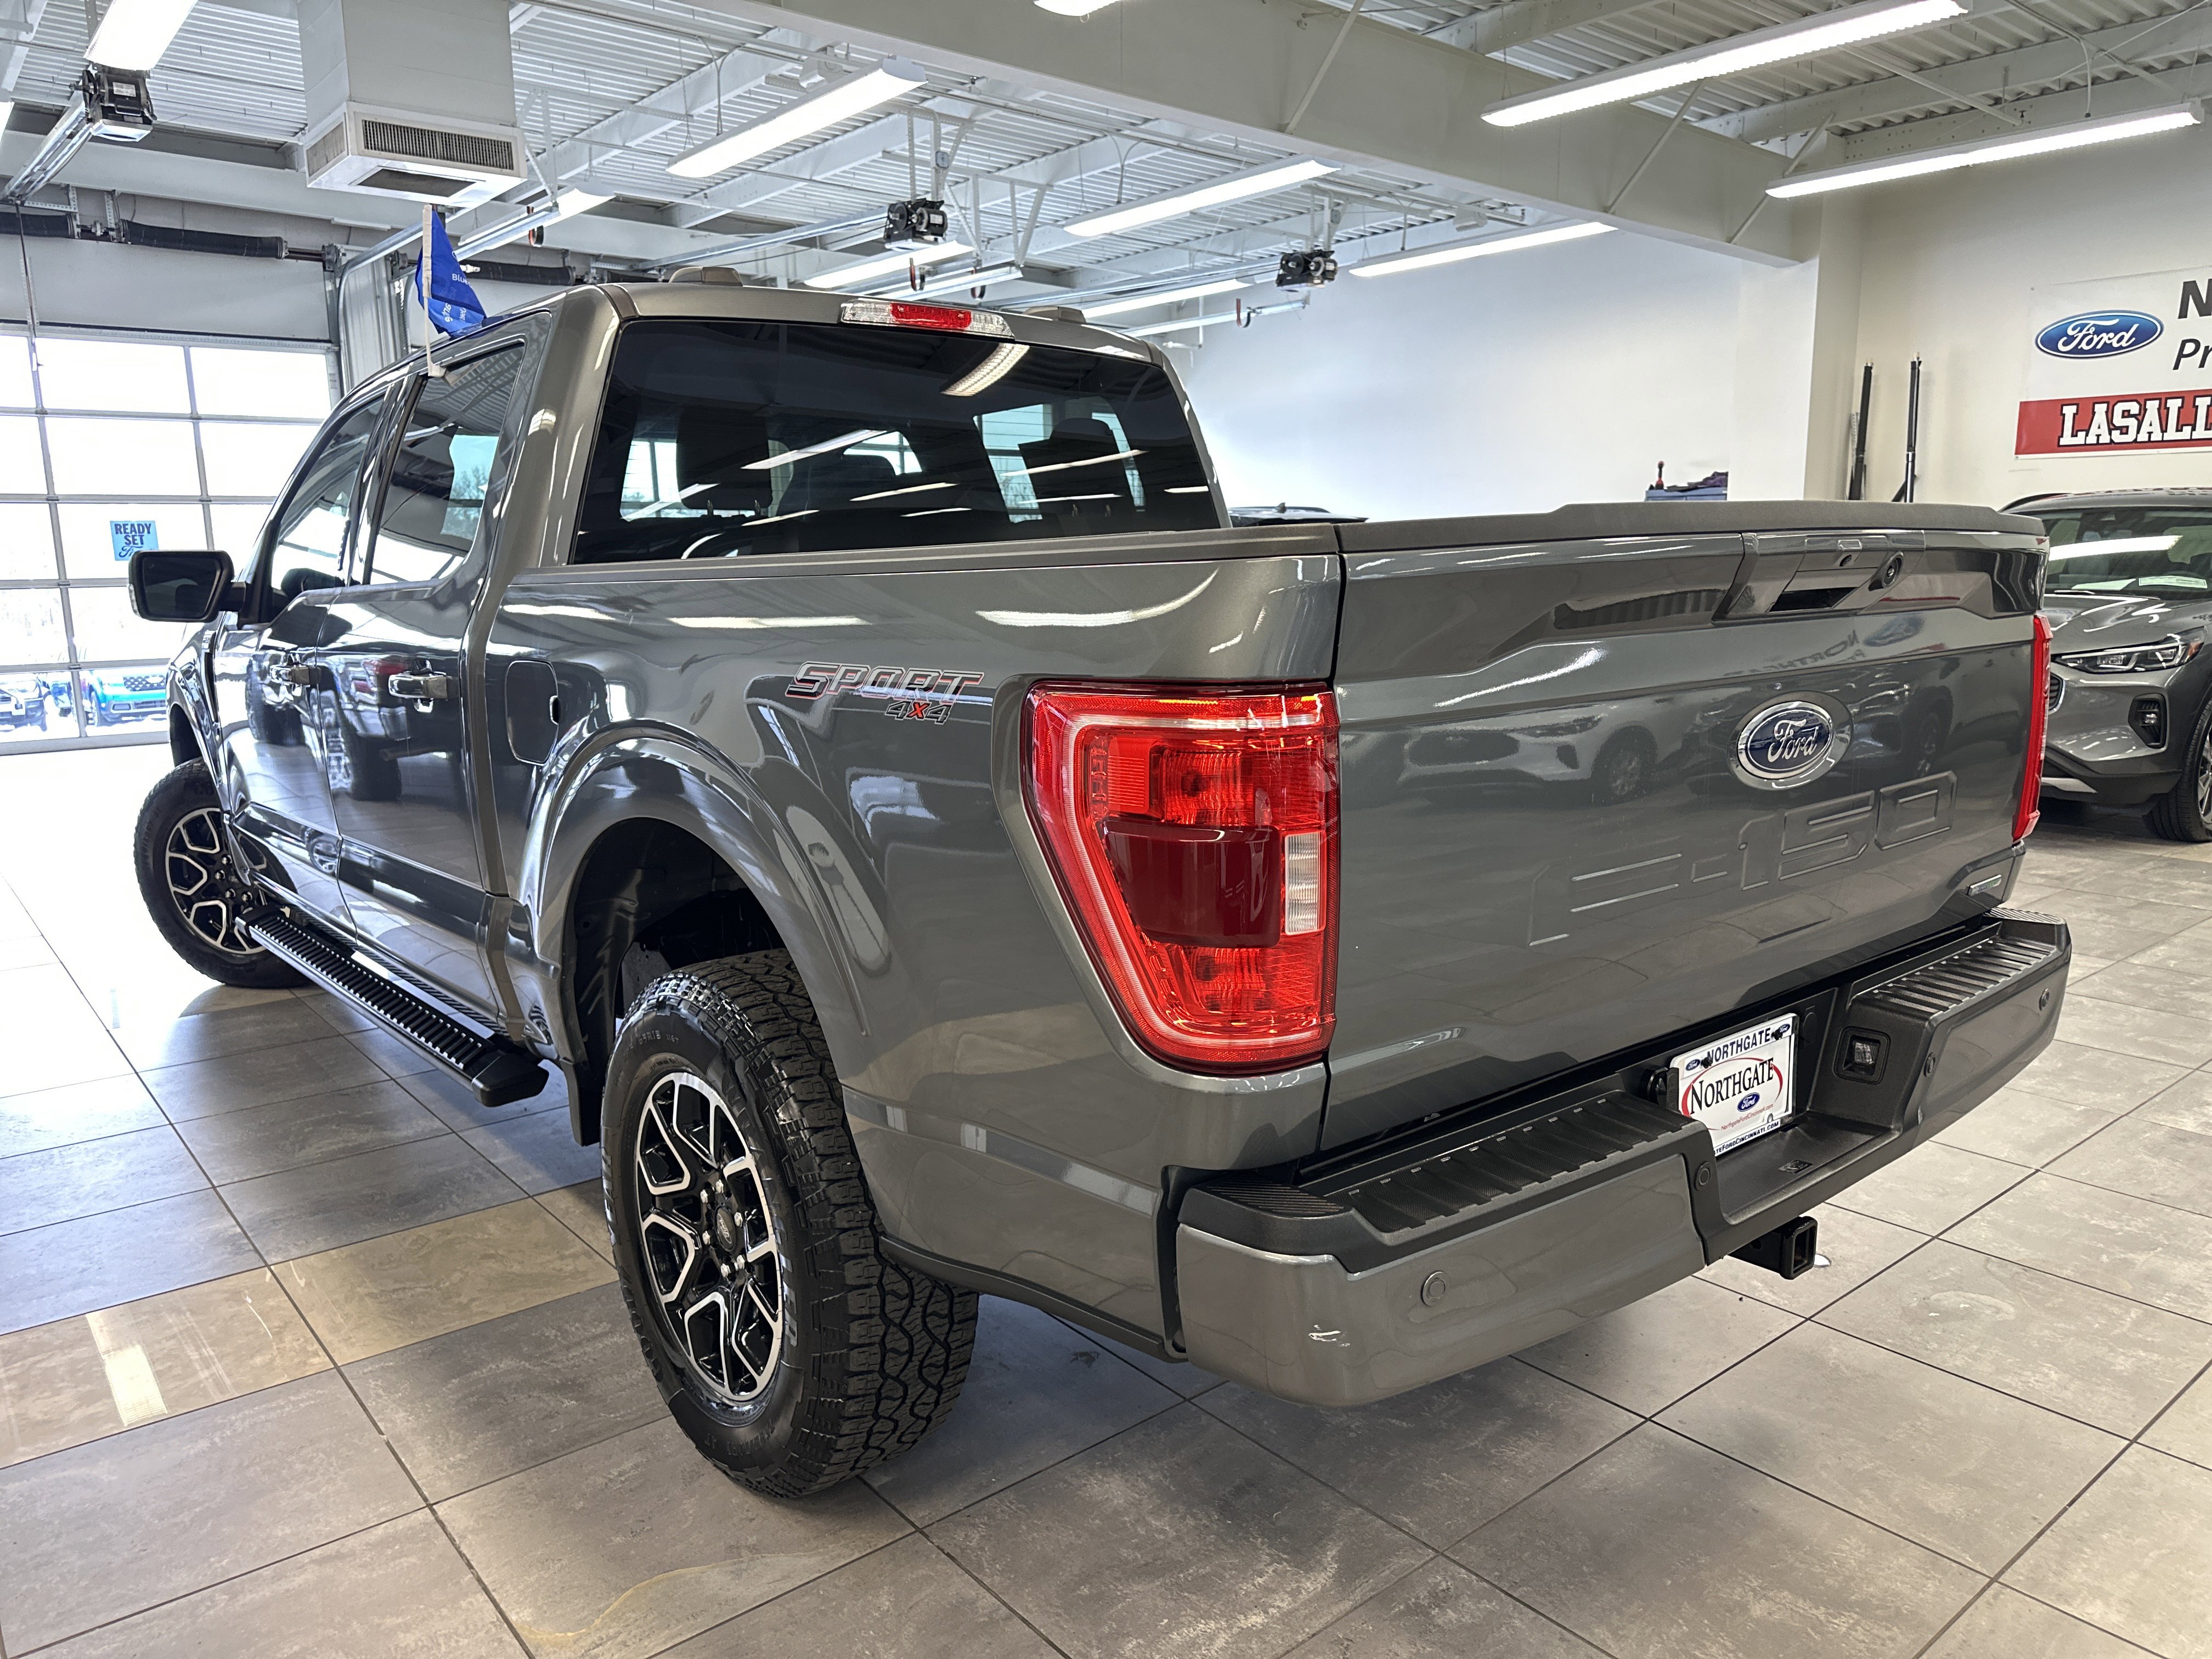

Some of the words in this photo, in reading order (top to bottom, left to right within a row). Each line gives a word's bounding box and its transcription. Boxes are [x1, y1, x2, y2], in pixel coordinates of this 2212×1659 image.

[2057, 318, 2140, 352] Ford
[114, 523, 151, 534] READY
[124, 535, 144, 545] SET
[785, 661, 984, 706] SPORT
[1768, 719, 1819, 763] Ford
[1707, 1027, 1771, 1063] NORTHGATE
[1690, 1057, 1774, 1115] NORTHGATE
